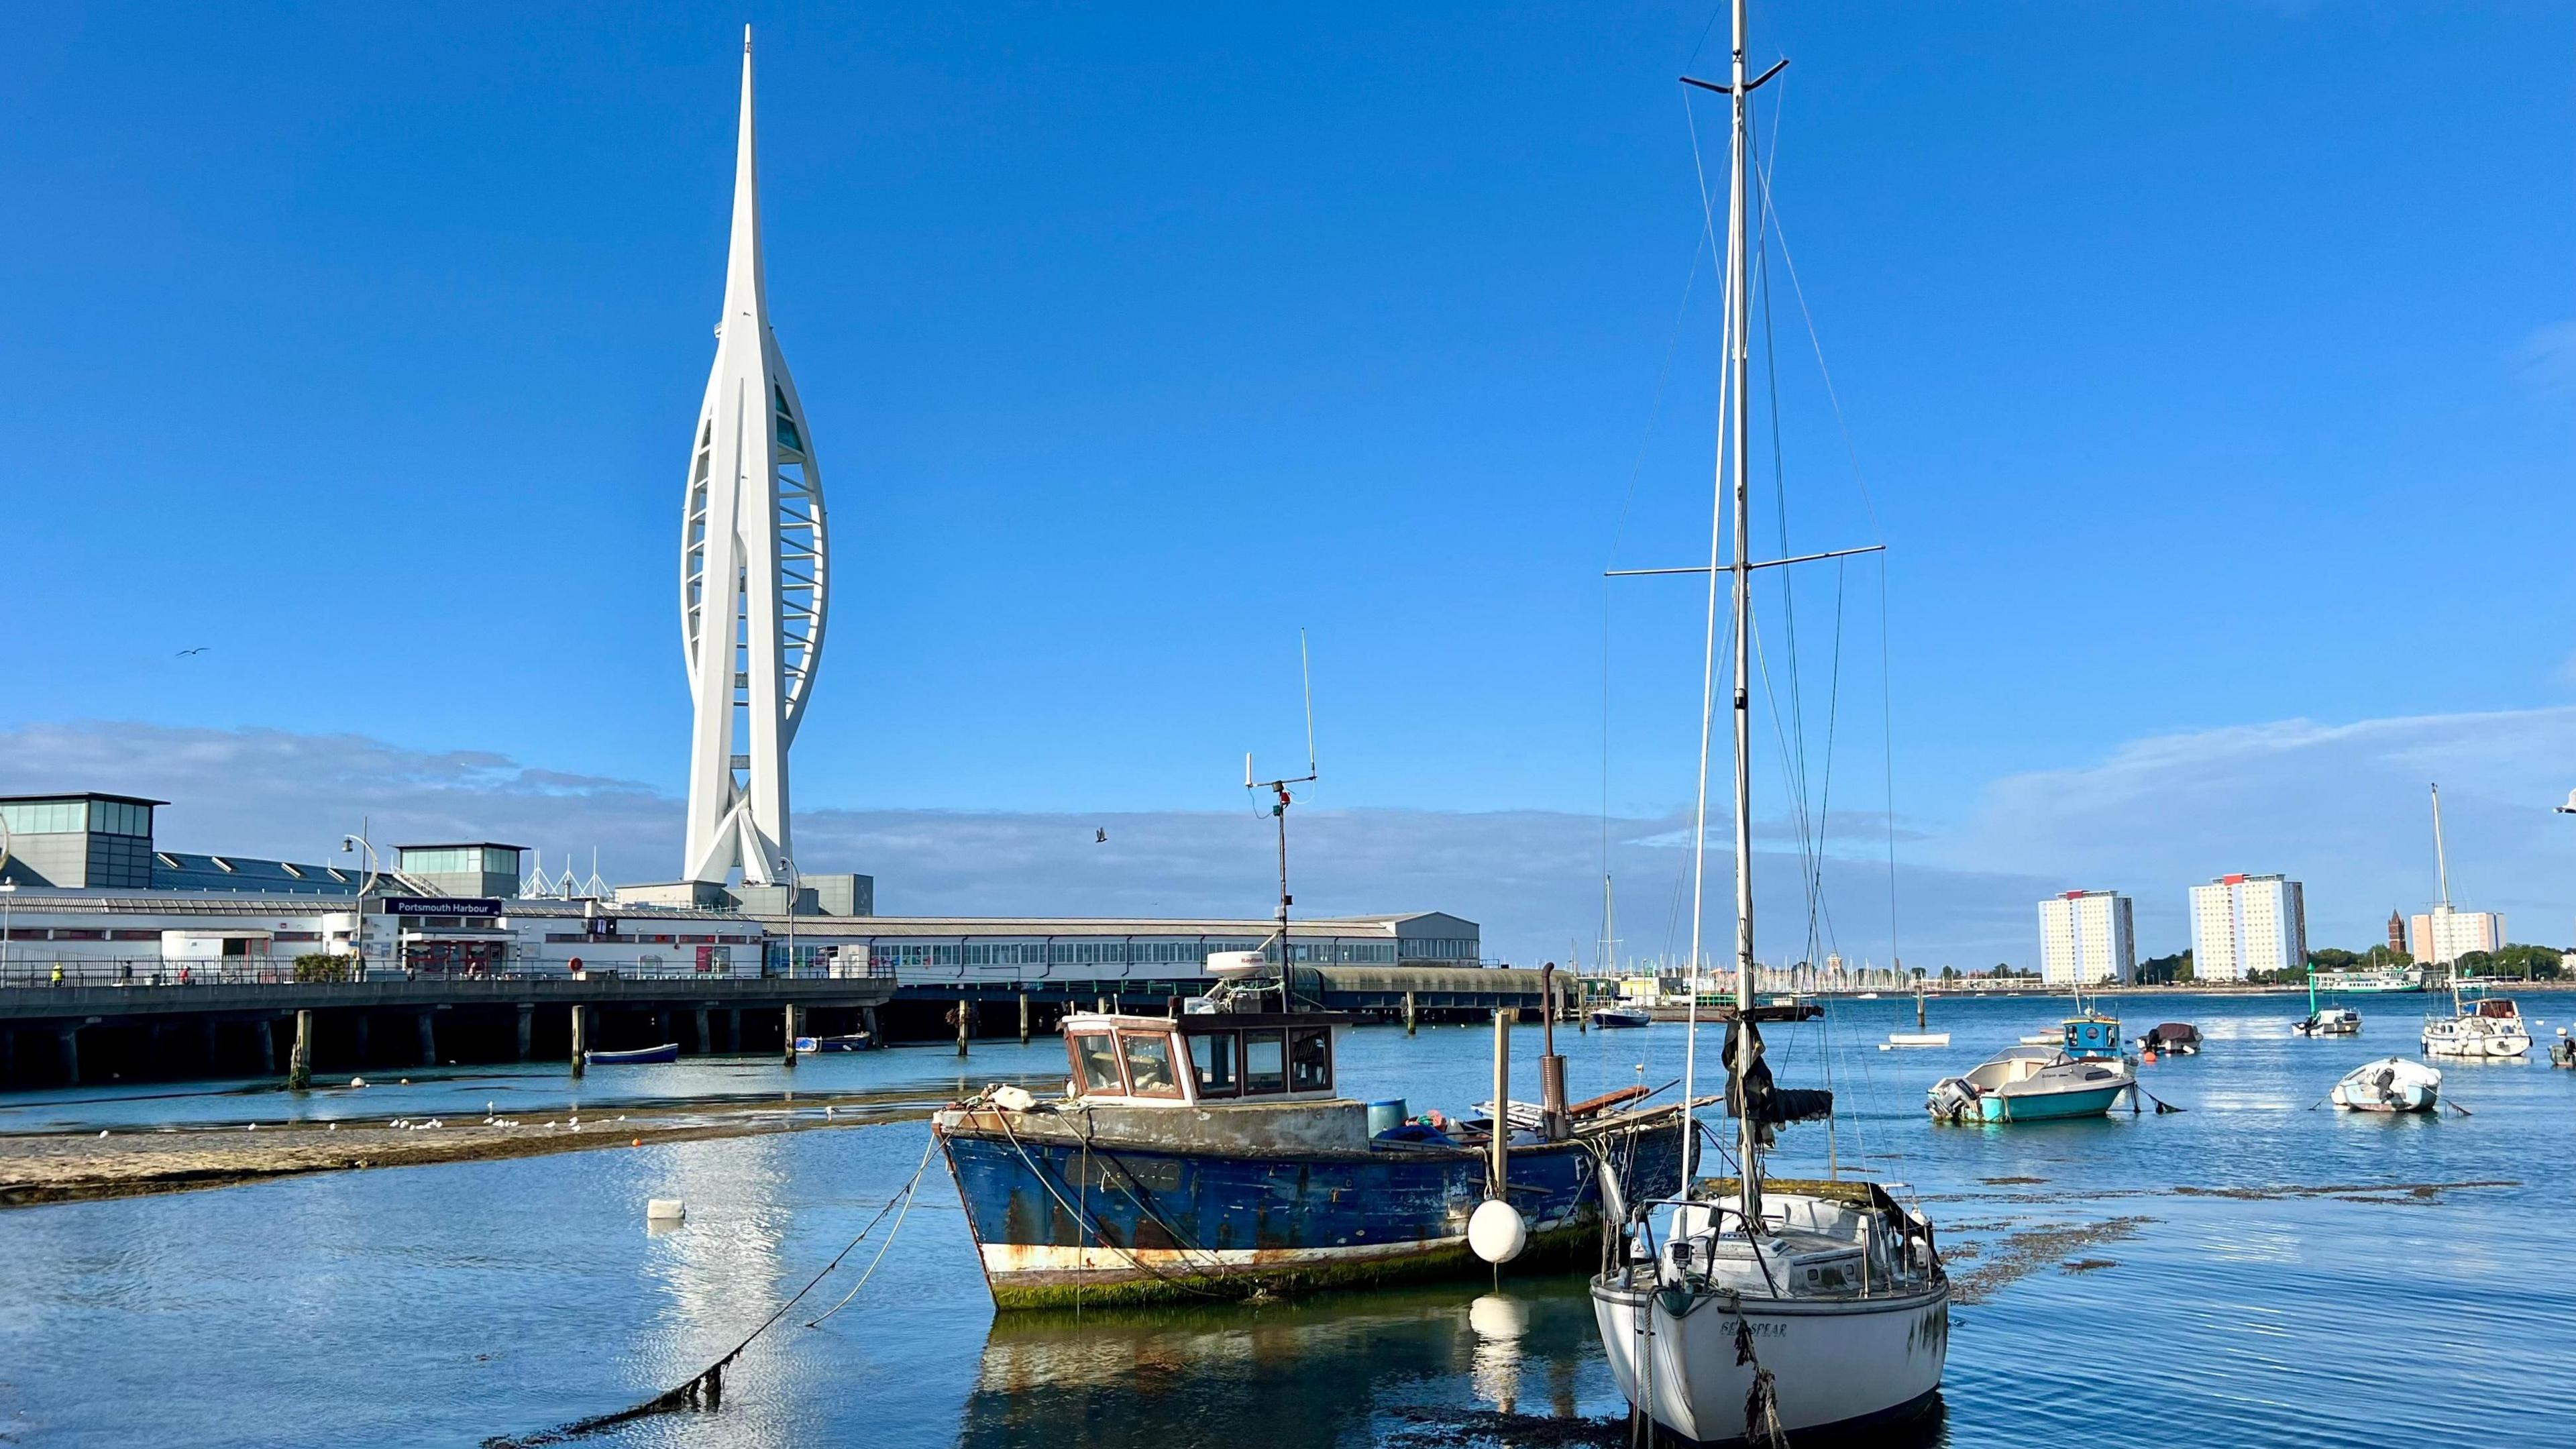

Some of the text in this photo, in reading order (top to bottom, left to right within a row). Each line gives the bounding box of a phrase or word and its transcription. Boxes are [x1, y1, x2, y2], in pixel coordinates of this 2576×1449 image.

[398, 902, 488, 913] Portsmouth Harbour
[1750, 1322, 1788, 1338] SPEAR
